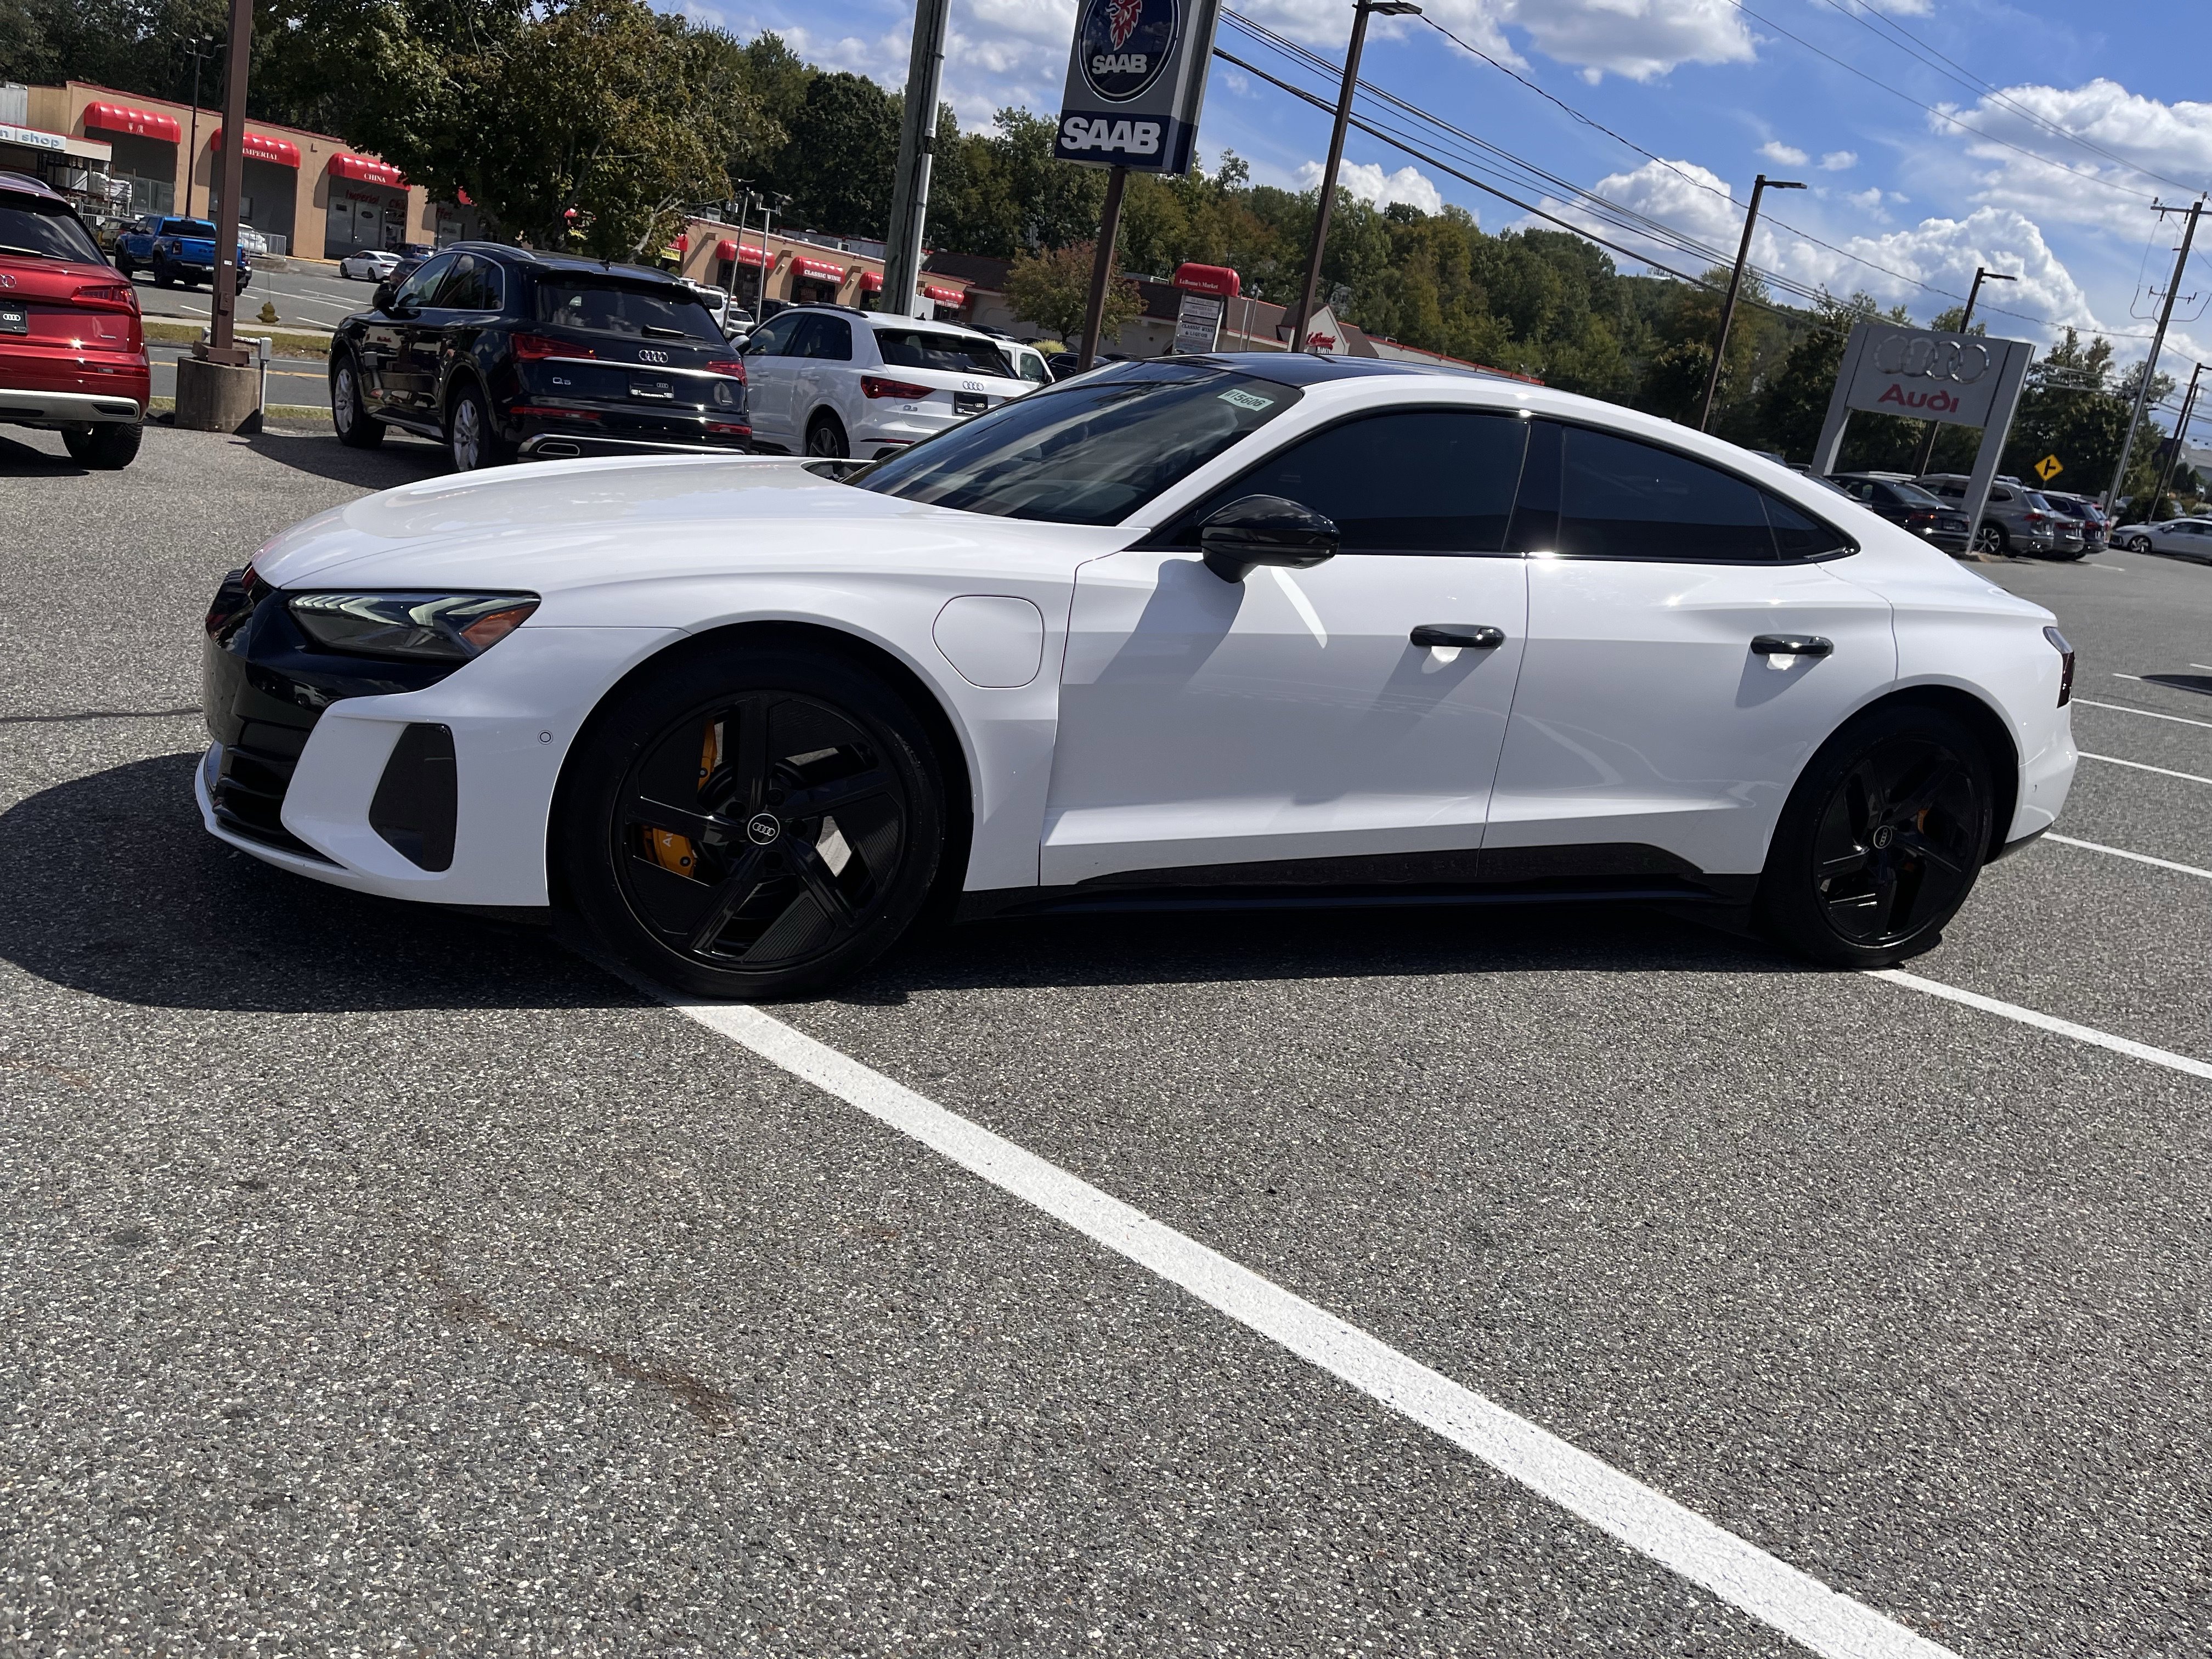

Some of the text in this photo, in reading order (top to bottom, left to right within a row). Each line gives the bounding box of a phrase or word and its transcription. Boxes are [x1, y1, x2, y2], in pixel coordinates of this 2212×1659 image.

[1092, 54, 1147, 75] SAAB
[21, 132, 60, 148] shop
[1061, 116, 1161, 154] SAAB
[242, 148, 279, 161] IMPERIAL
[364, 173, 386, 183] CHINA
[804, 269, 841, 282] CLASSIC WINE
[1877, 383, 1960, 413] Audi
